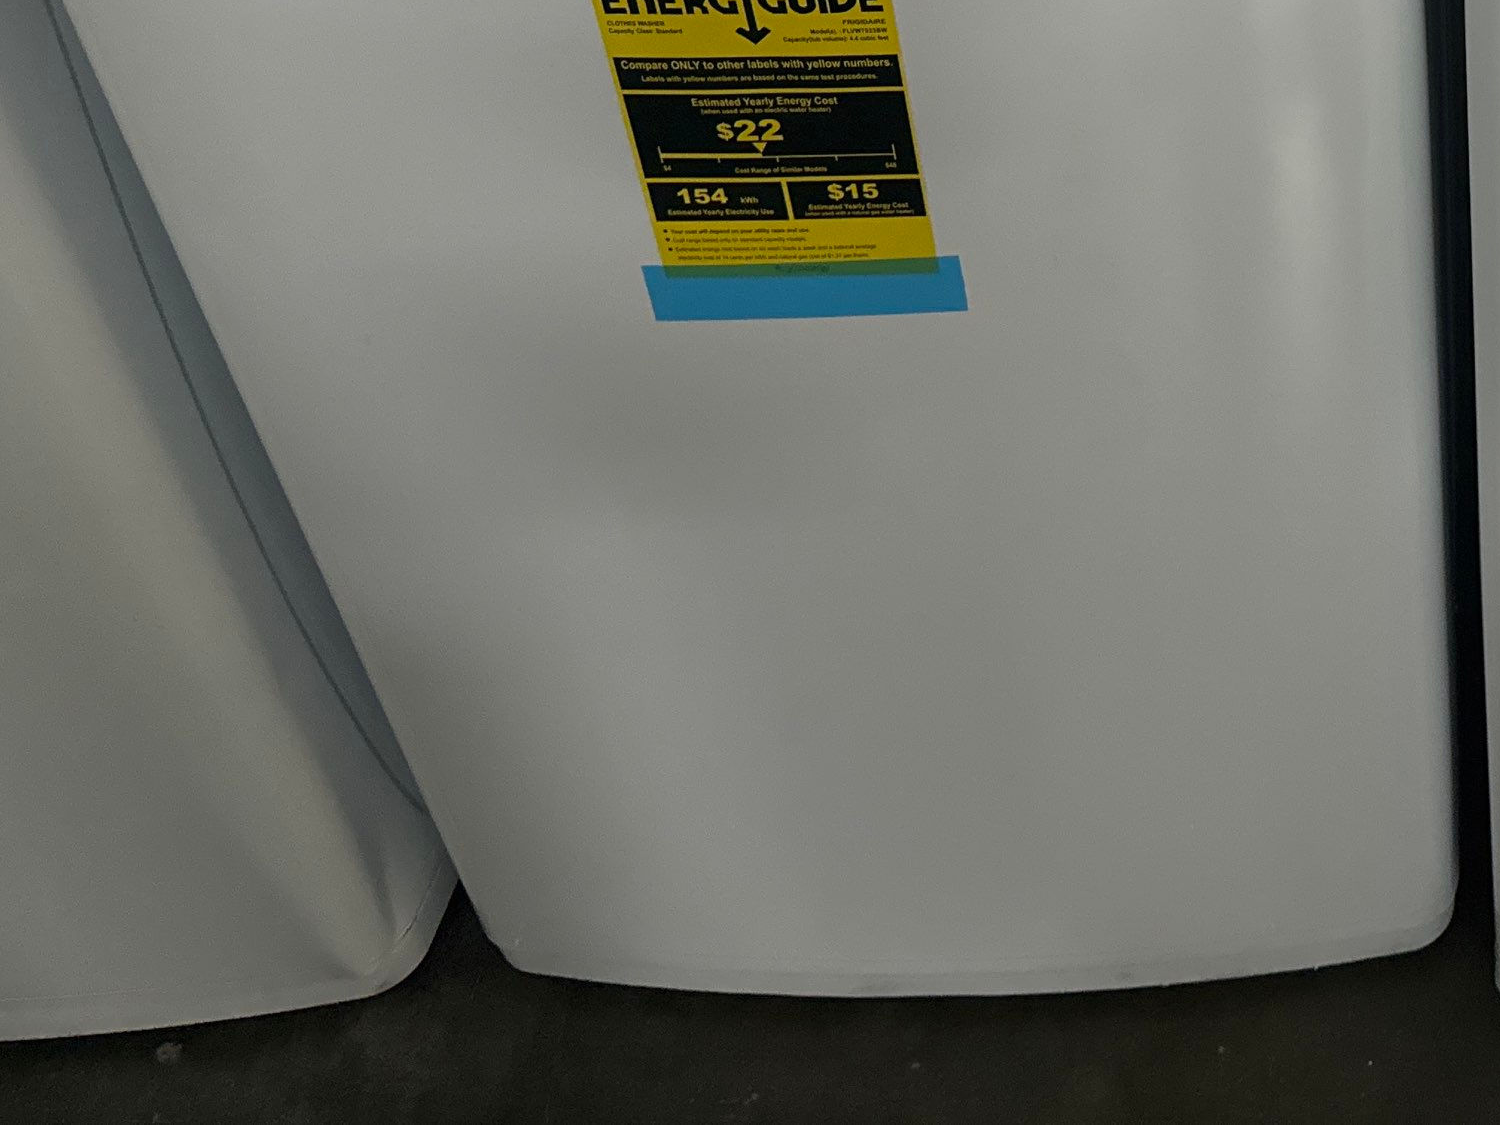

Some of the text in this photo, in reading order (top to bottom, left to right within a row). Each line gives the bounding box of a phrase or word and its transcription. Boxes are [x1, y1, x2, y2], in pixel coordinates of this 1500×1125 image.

[620, 57, 894, 71] Compare ONLY to other labels with yellow numbers.
[683, 75, 706, 83] yellow
[836, 73, 879, 81] procedures.
[690, 96, 839, 107] Estimated Yearly Energy Cost
[716, 119, 785, 142] $22
[735, 166, 750, 174] Cost
[751, 166, 772, 175] Range
[676, 188, 759, 204] 154 kWh
[827, 183, 879, 201] $15
[844, 203, 866, 211] Yearly
[867, 202, 891, 210] Energy
[703, 208, 724, 217] Yearly
[725, 208, 759, 216] Electricity
